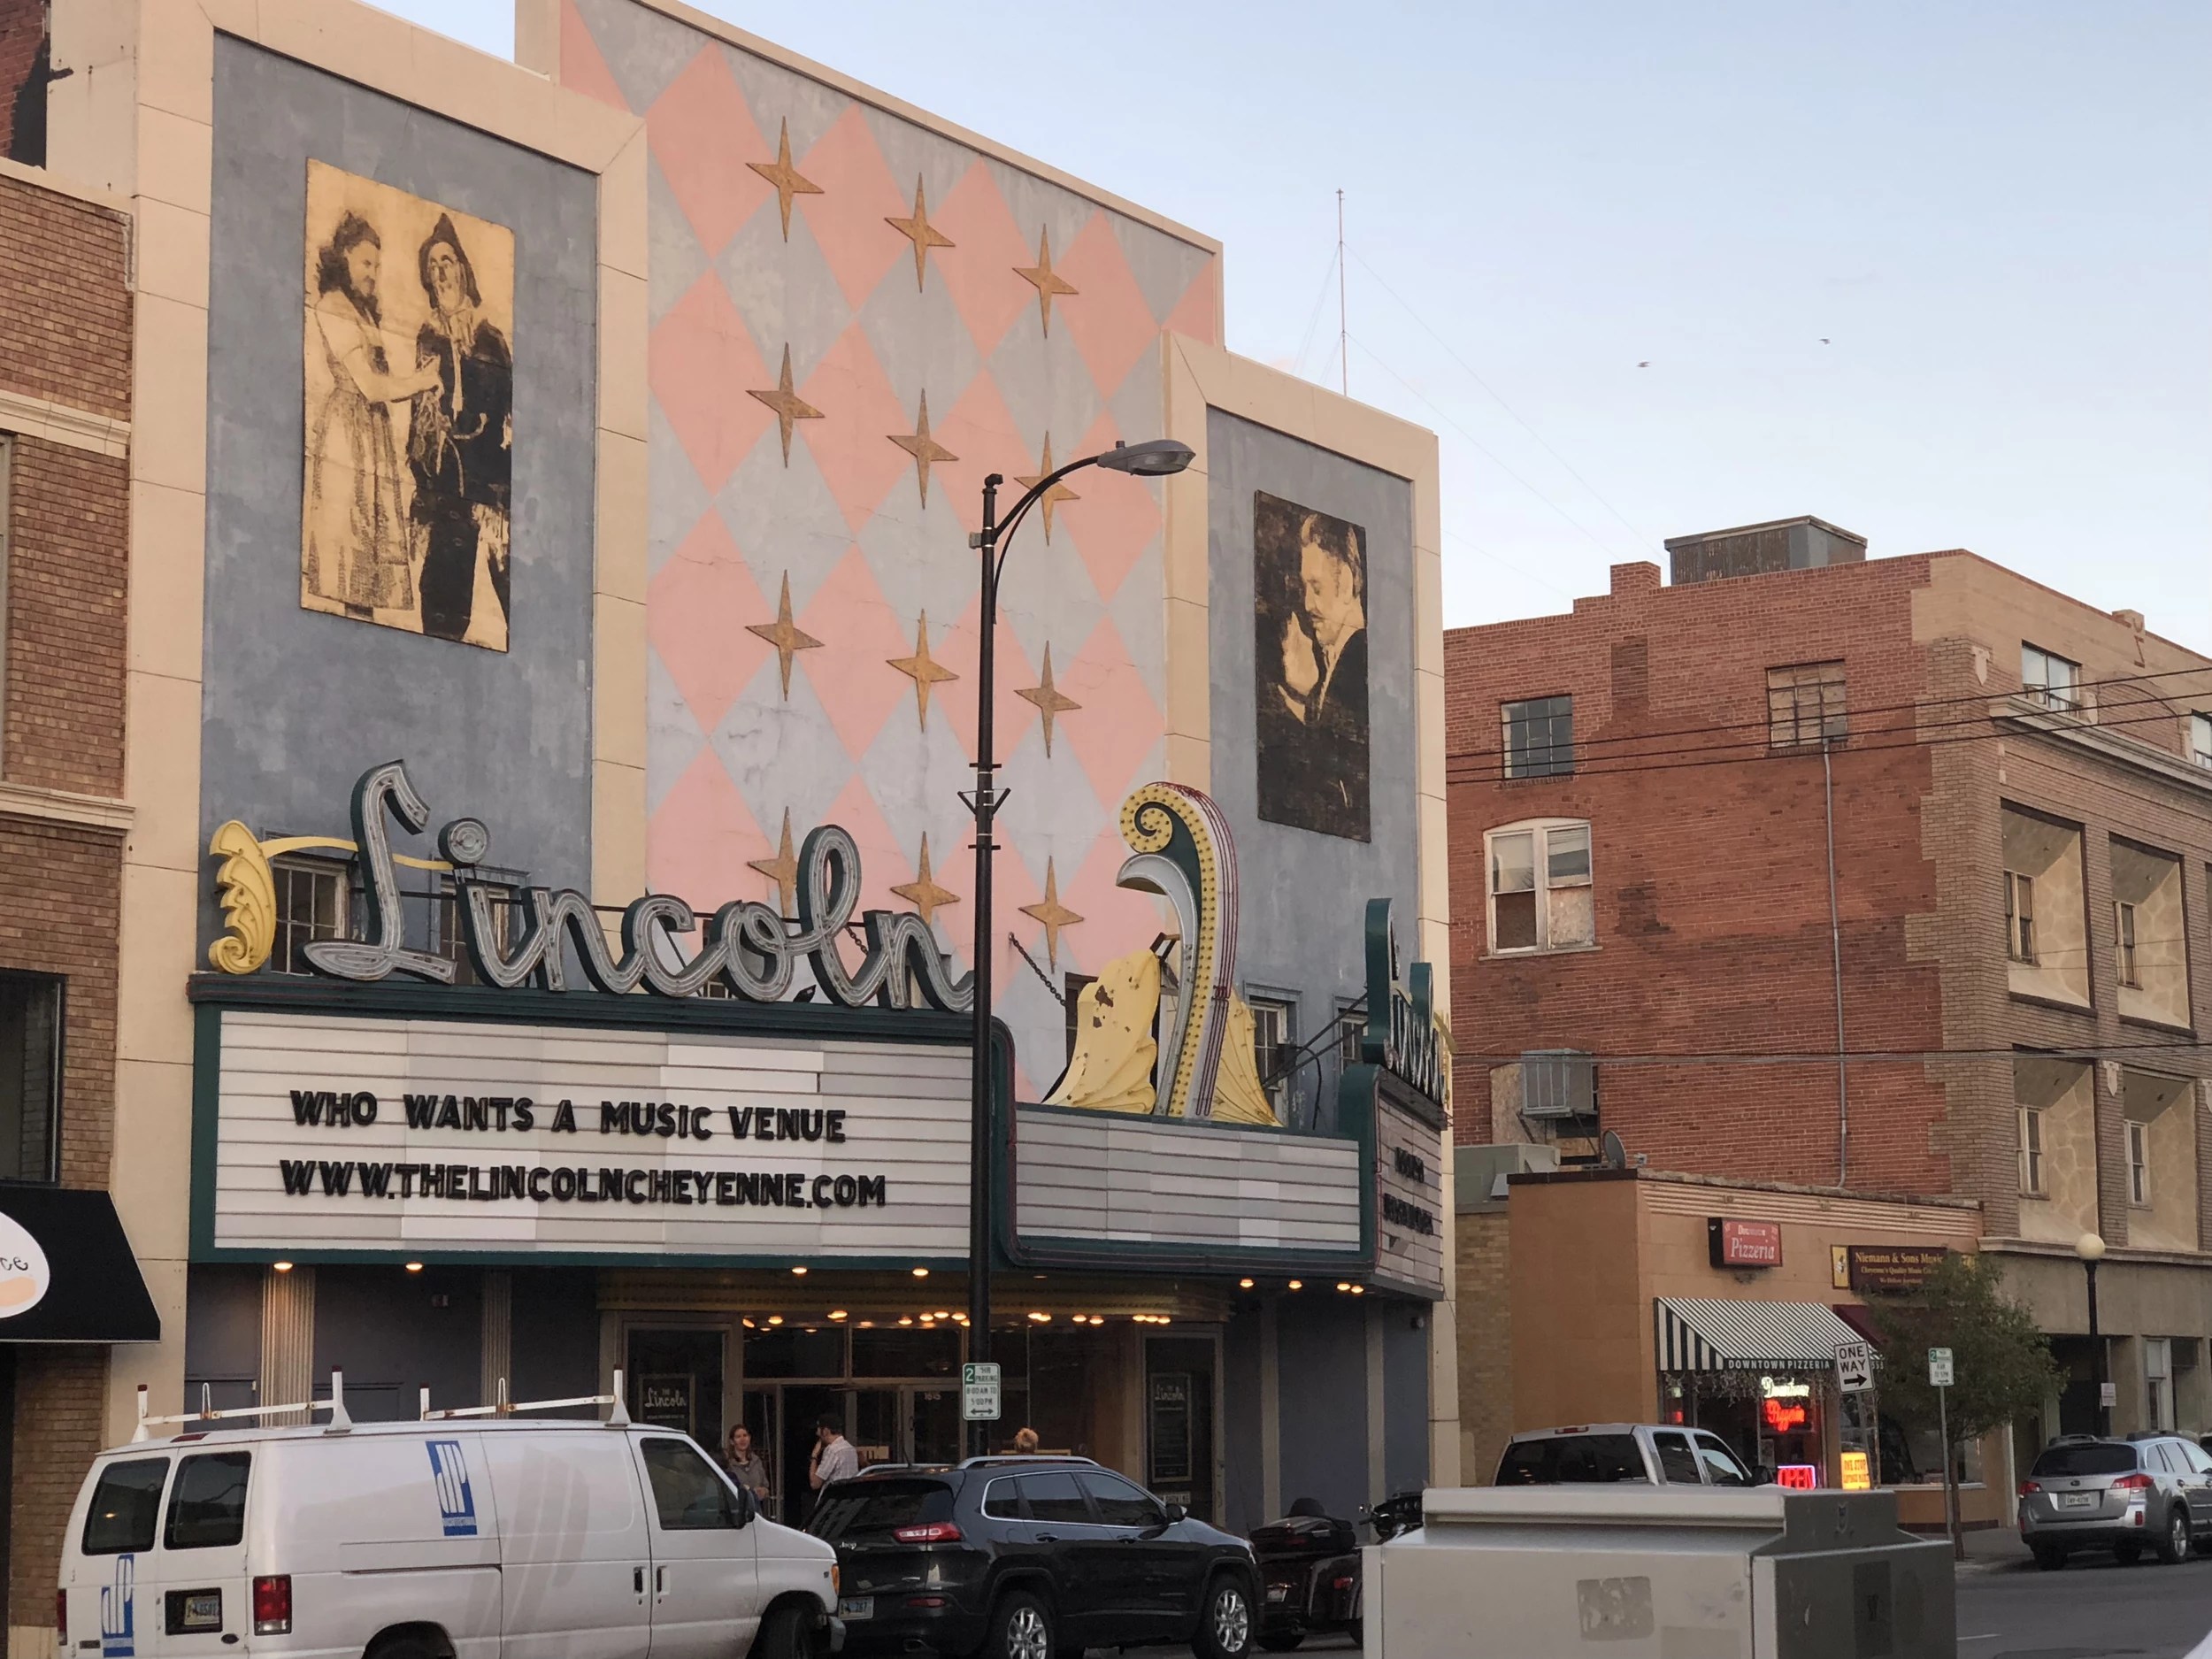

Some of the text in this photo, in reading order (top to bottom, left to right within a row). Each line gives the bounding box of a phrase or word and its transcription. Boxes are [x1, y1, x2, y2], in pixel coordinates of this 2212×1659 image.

[301, 758, 974, 1013] Lincoln
[289, 1090, 847, 1144] WHO WANTS A MUSIC VENUE
[280, 1159, 887, 1209] WWW.THELINCOLNCHEYENNE.COM
[1731, 1237, 1775, 1259] Pizzeria
[1855, 1252, 1890, 1263] Niemann
[1892, 1252, 1900, 1263] &
[1901, 1253, 1919, 1263] Sons
[1839, 1345, 1865, 1360] ONE
[1930, 1350, 1937, 1362] 2
[1728, 1359, 1786, 1370] DOWNTOWN
[1787, 1360, 1831, 1370] PIZZERIA
[1839, 1359, 1867, 1374] WAY
[965, 1367, 974, 1382] 2
[644, 1387, 687, 1408] Lincoln
[1778, 1468, 1813, 1490] OPEN
